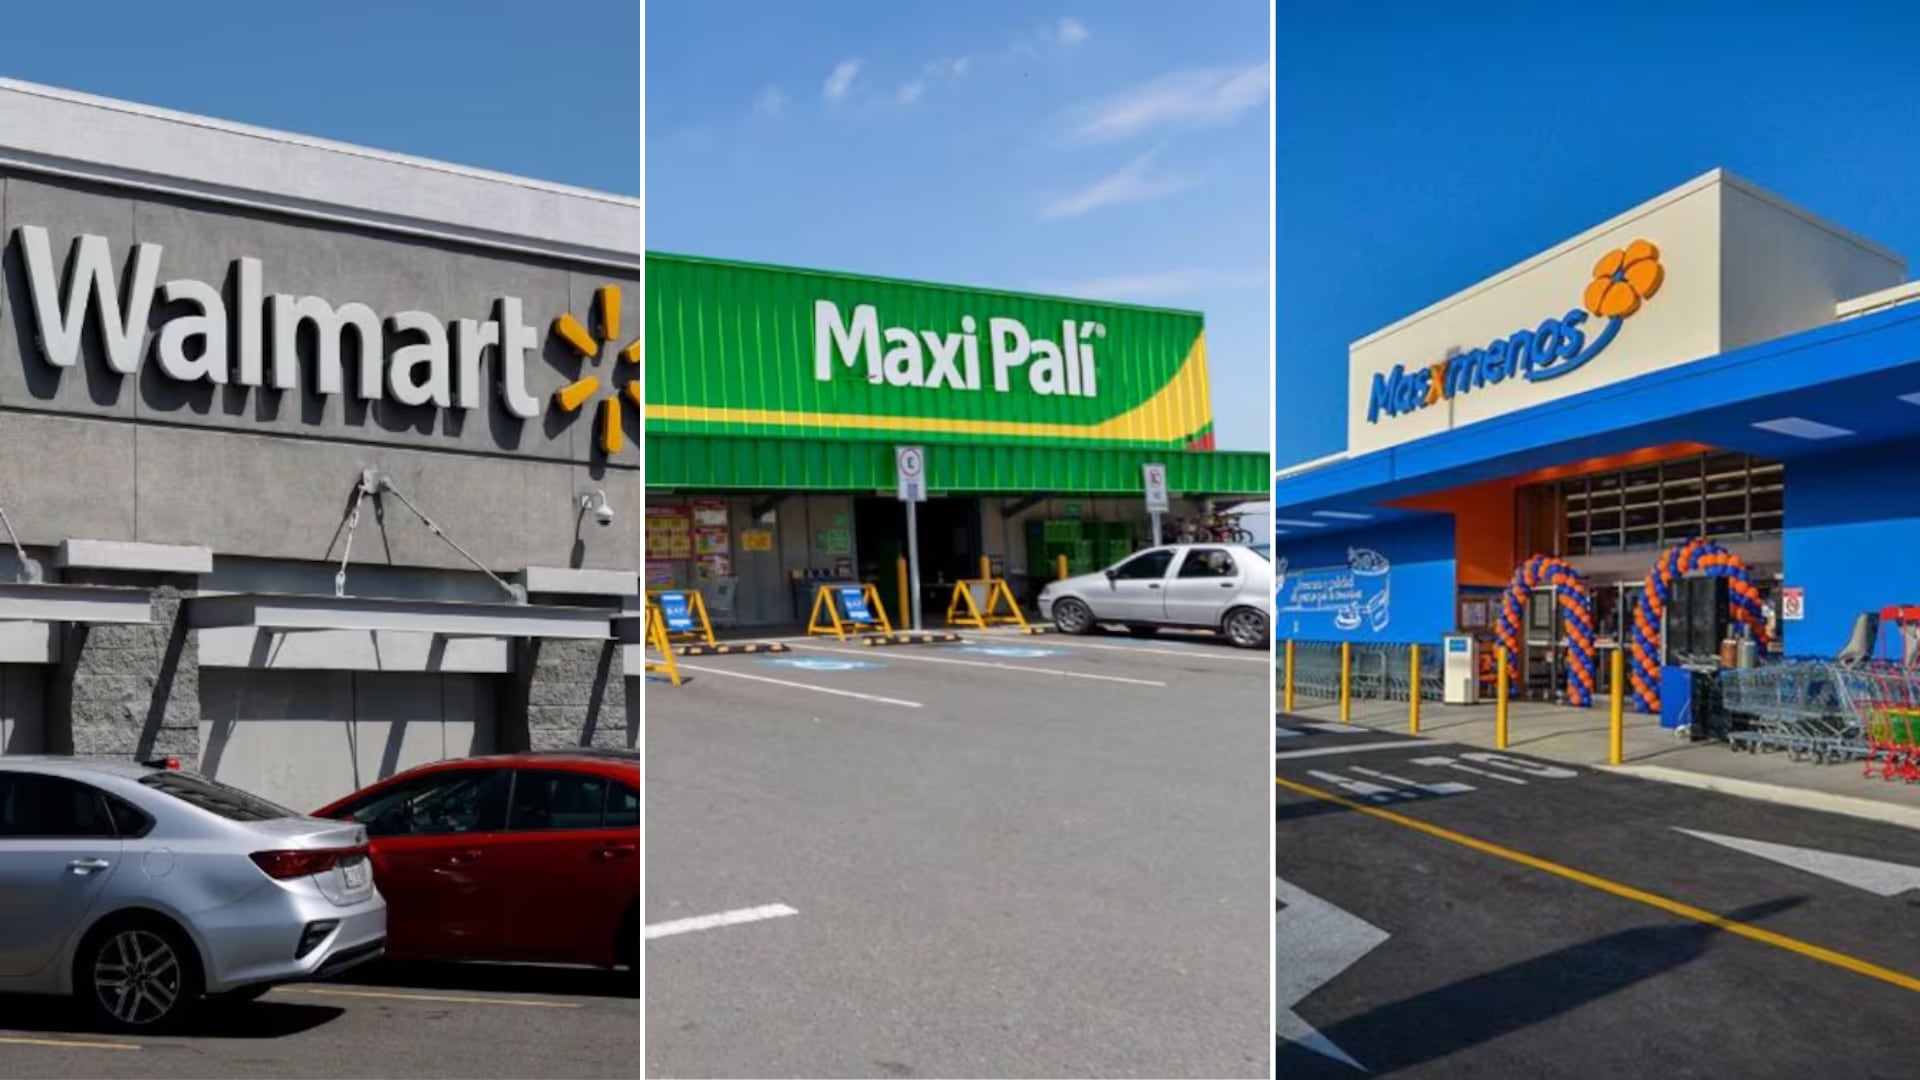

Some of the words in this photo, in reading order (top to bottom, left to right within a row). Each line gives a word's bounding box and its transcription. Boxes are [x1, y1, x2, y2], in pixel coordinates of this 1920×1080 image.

[18, 225, 540, 418] Walmart
[815, 299, 981, 391] Maxi
[989, 317, 1097, 397] Palí
[1306, 752, 1579, 802] ALTO
